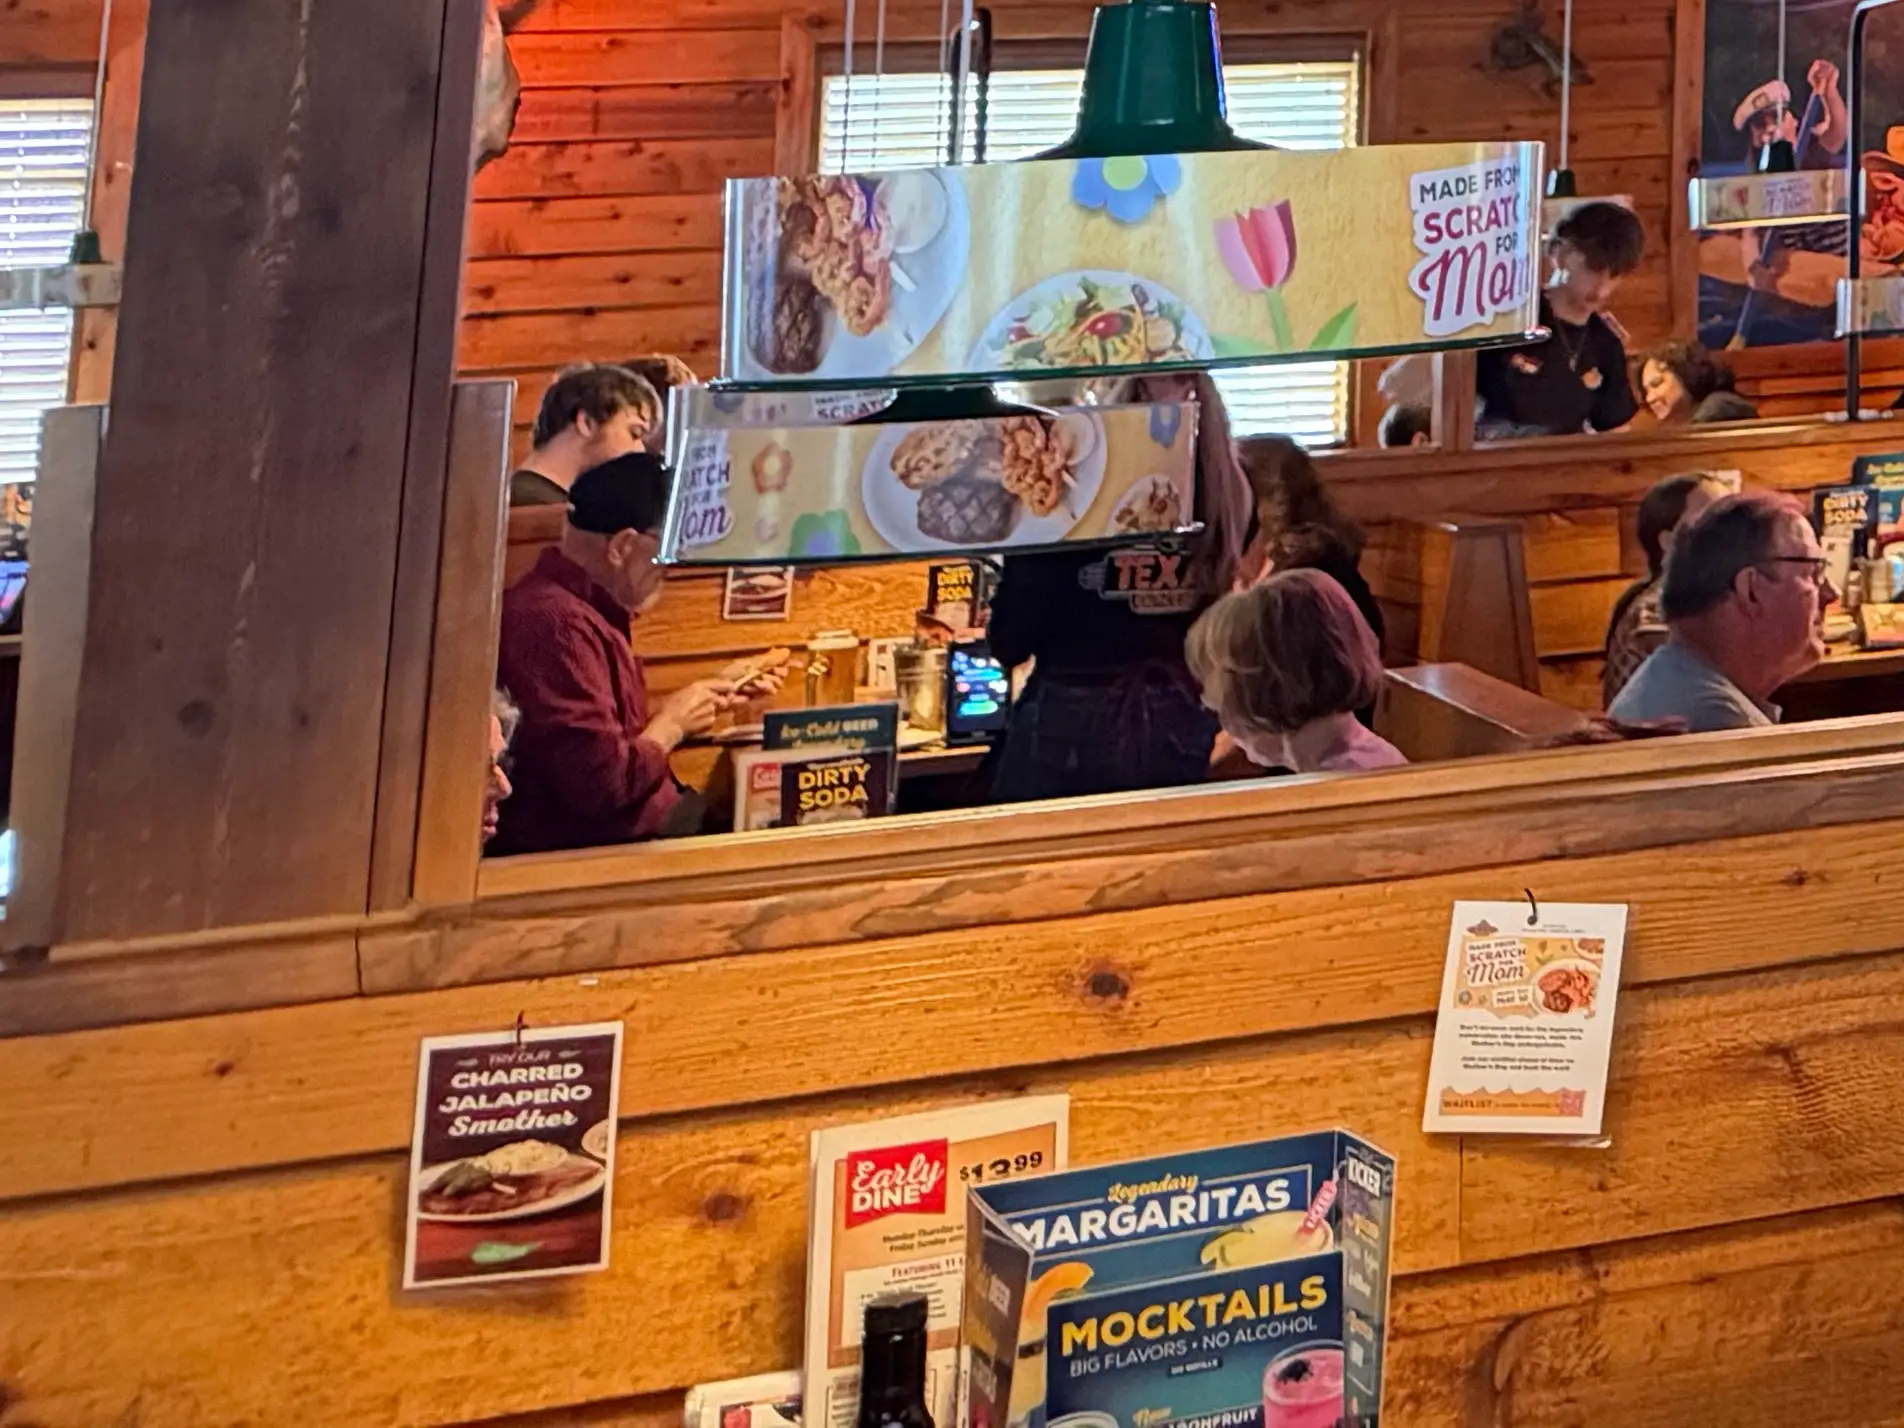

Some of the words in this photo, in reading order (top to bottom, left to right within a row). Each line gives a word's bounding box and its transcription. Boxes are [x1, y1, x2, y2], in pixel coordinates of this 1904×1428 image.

[1419, 174, 1479, 204] MADE
[798, 763, 871, 790] DIRTY
[798, 784, 869, 810] SODA
[1469, 947, 1526, 963] SCRATCH
[1467, 961, 1524, 984] Mom
[450, 1063, 584, 1090] CHARRED
[438, 1082, 593, 1114] JALAPEÑO
[1443, 1100, 1493, 1110] WAITLIST
[447, 1108, 579, 1137] Smother
[851, 1152, 945, 1193] Early
[852, 1183, 922, 1213] DINE
[1107, 1172, 1199, 1204] Legendary
[1012, 1178, 1291, 1251] MARGARITAS
[1060, 1275, 1328, 1356] MOCKTAILS
[1069, 1357, 1100, 1378] BIG
[1104, 1339, 1187, 1372] FLAVORS
[1202, 1331, 1230, 1353] NO
[1233, 1314, 1319, 1346] ALCOHOL
